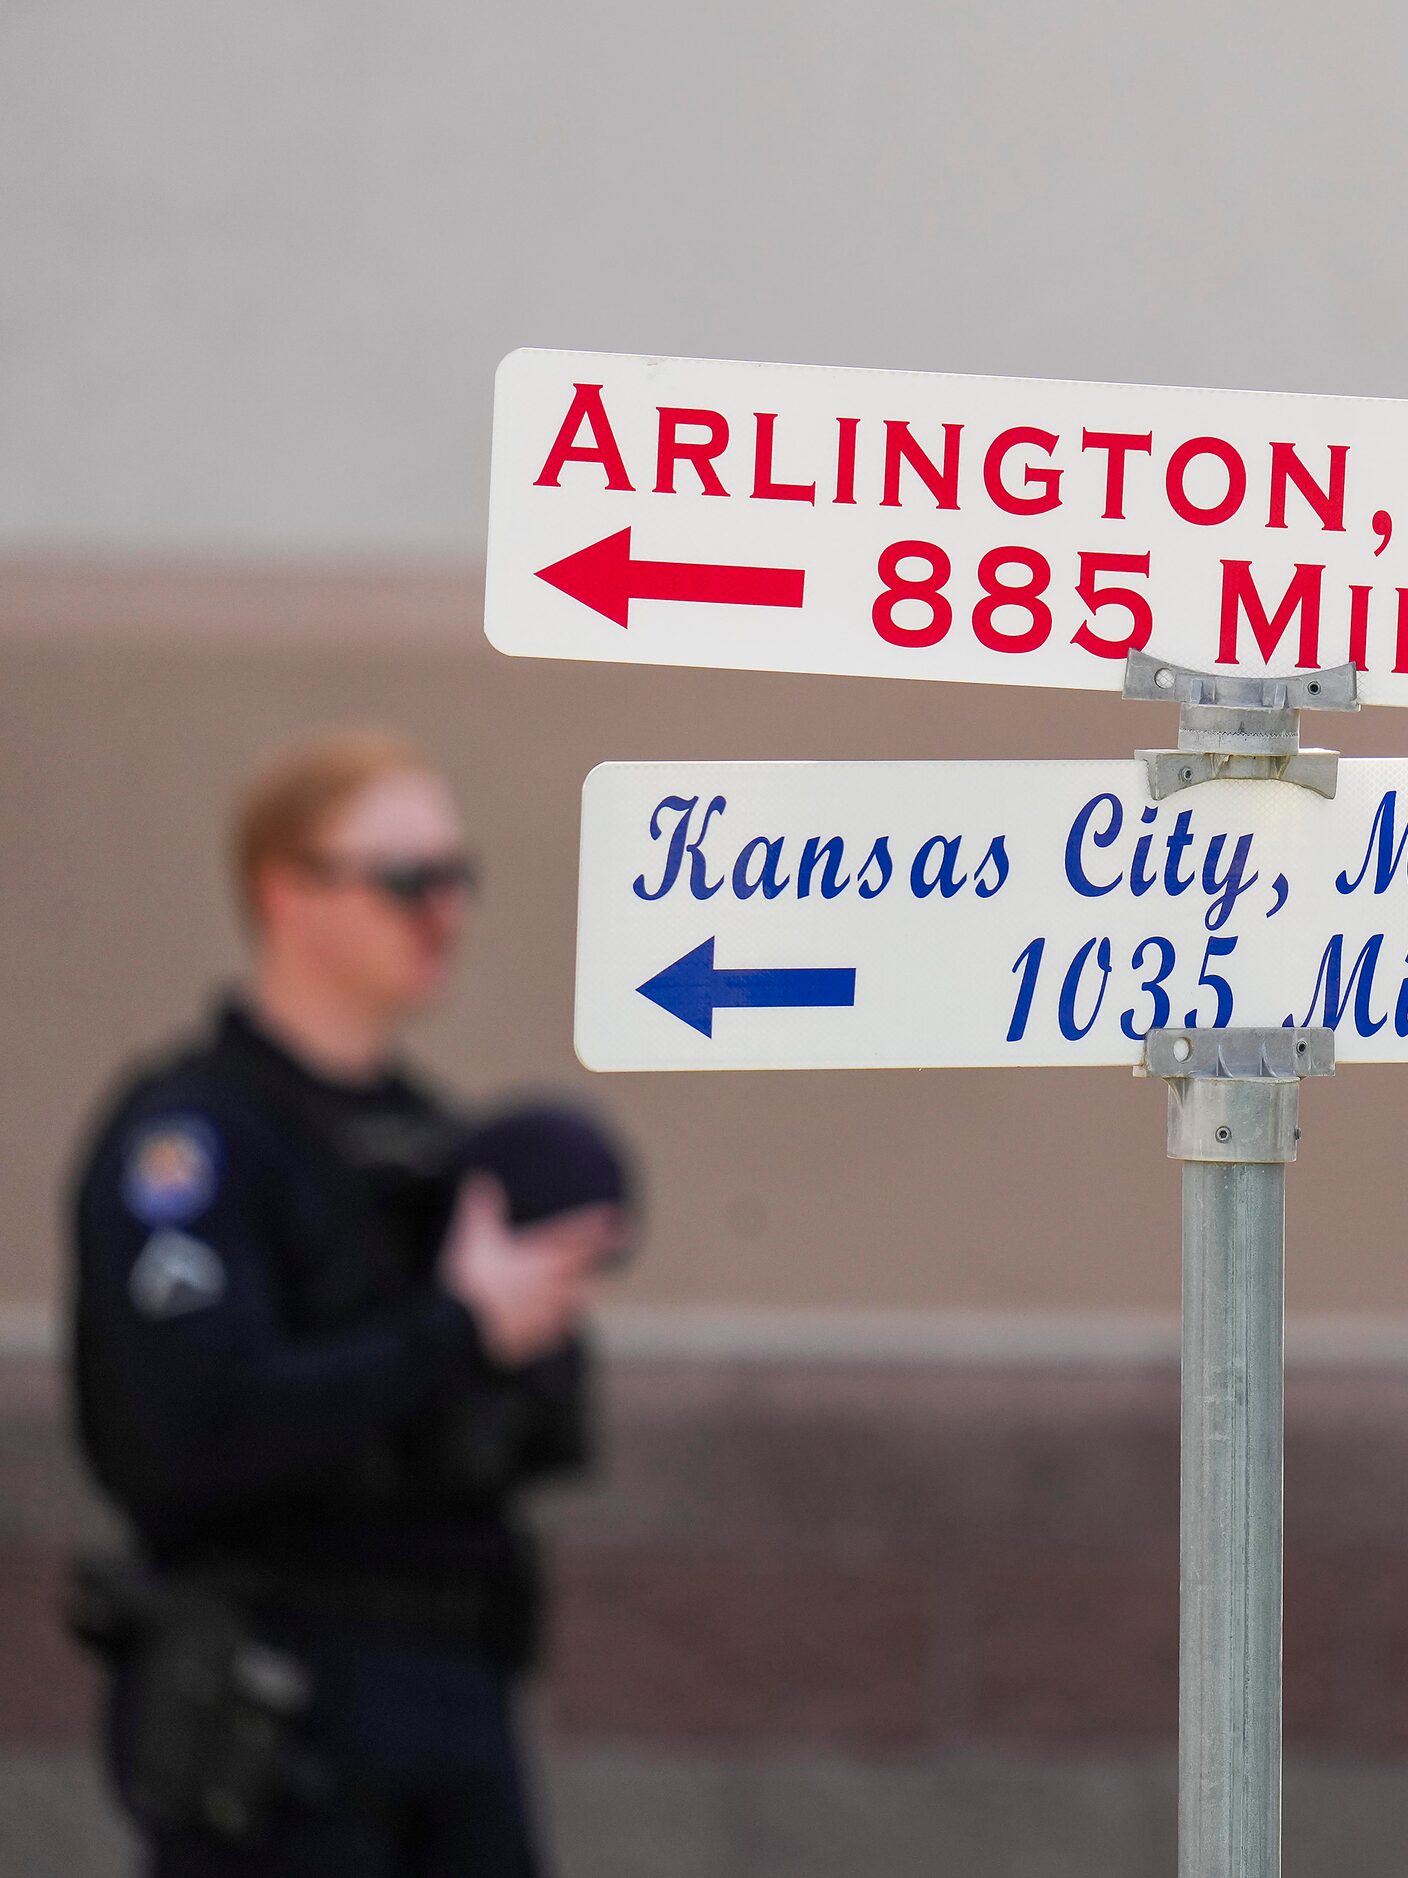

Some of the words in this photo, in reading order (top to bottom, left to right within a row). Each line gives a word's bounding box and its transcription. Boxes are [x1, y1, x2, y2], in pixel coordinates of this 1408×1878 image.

[533, 383, 1394, 557] ARLINGTON,
[871, 539, 1153, 660] 885
[632, 796, 1010, 902] Kansas
[1064, 793, 1289, 932] City,
[1006, 935, 1239, 1043] 1035
